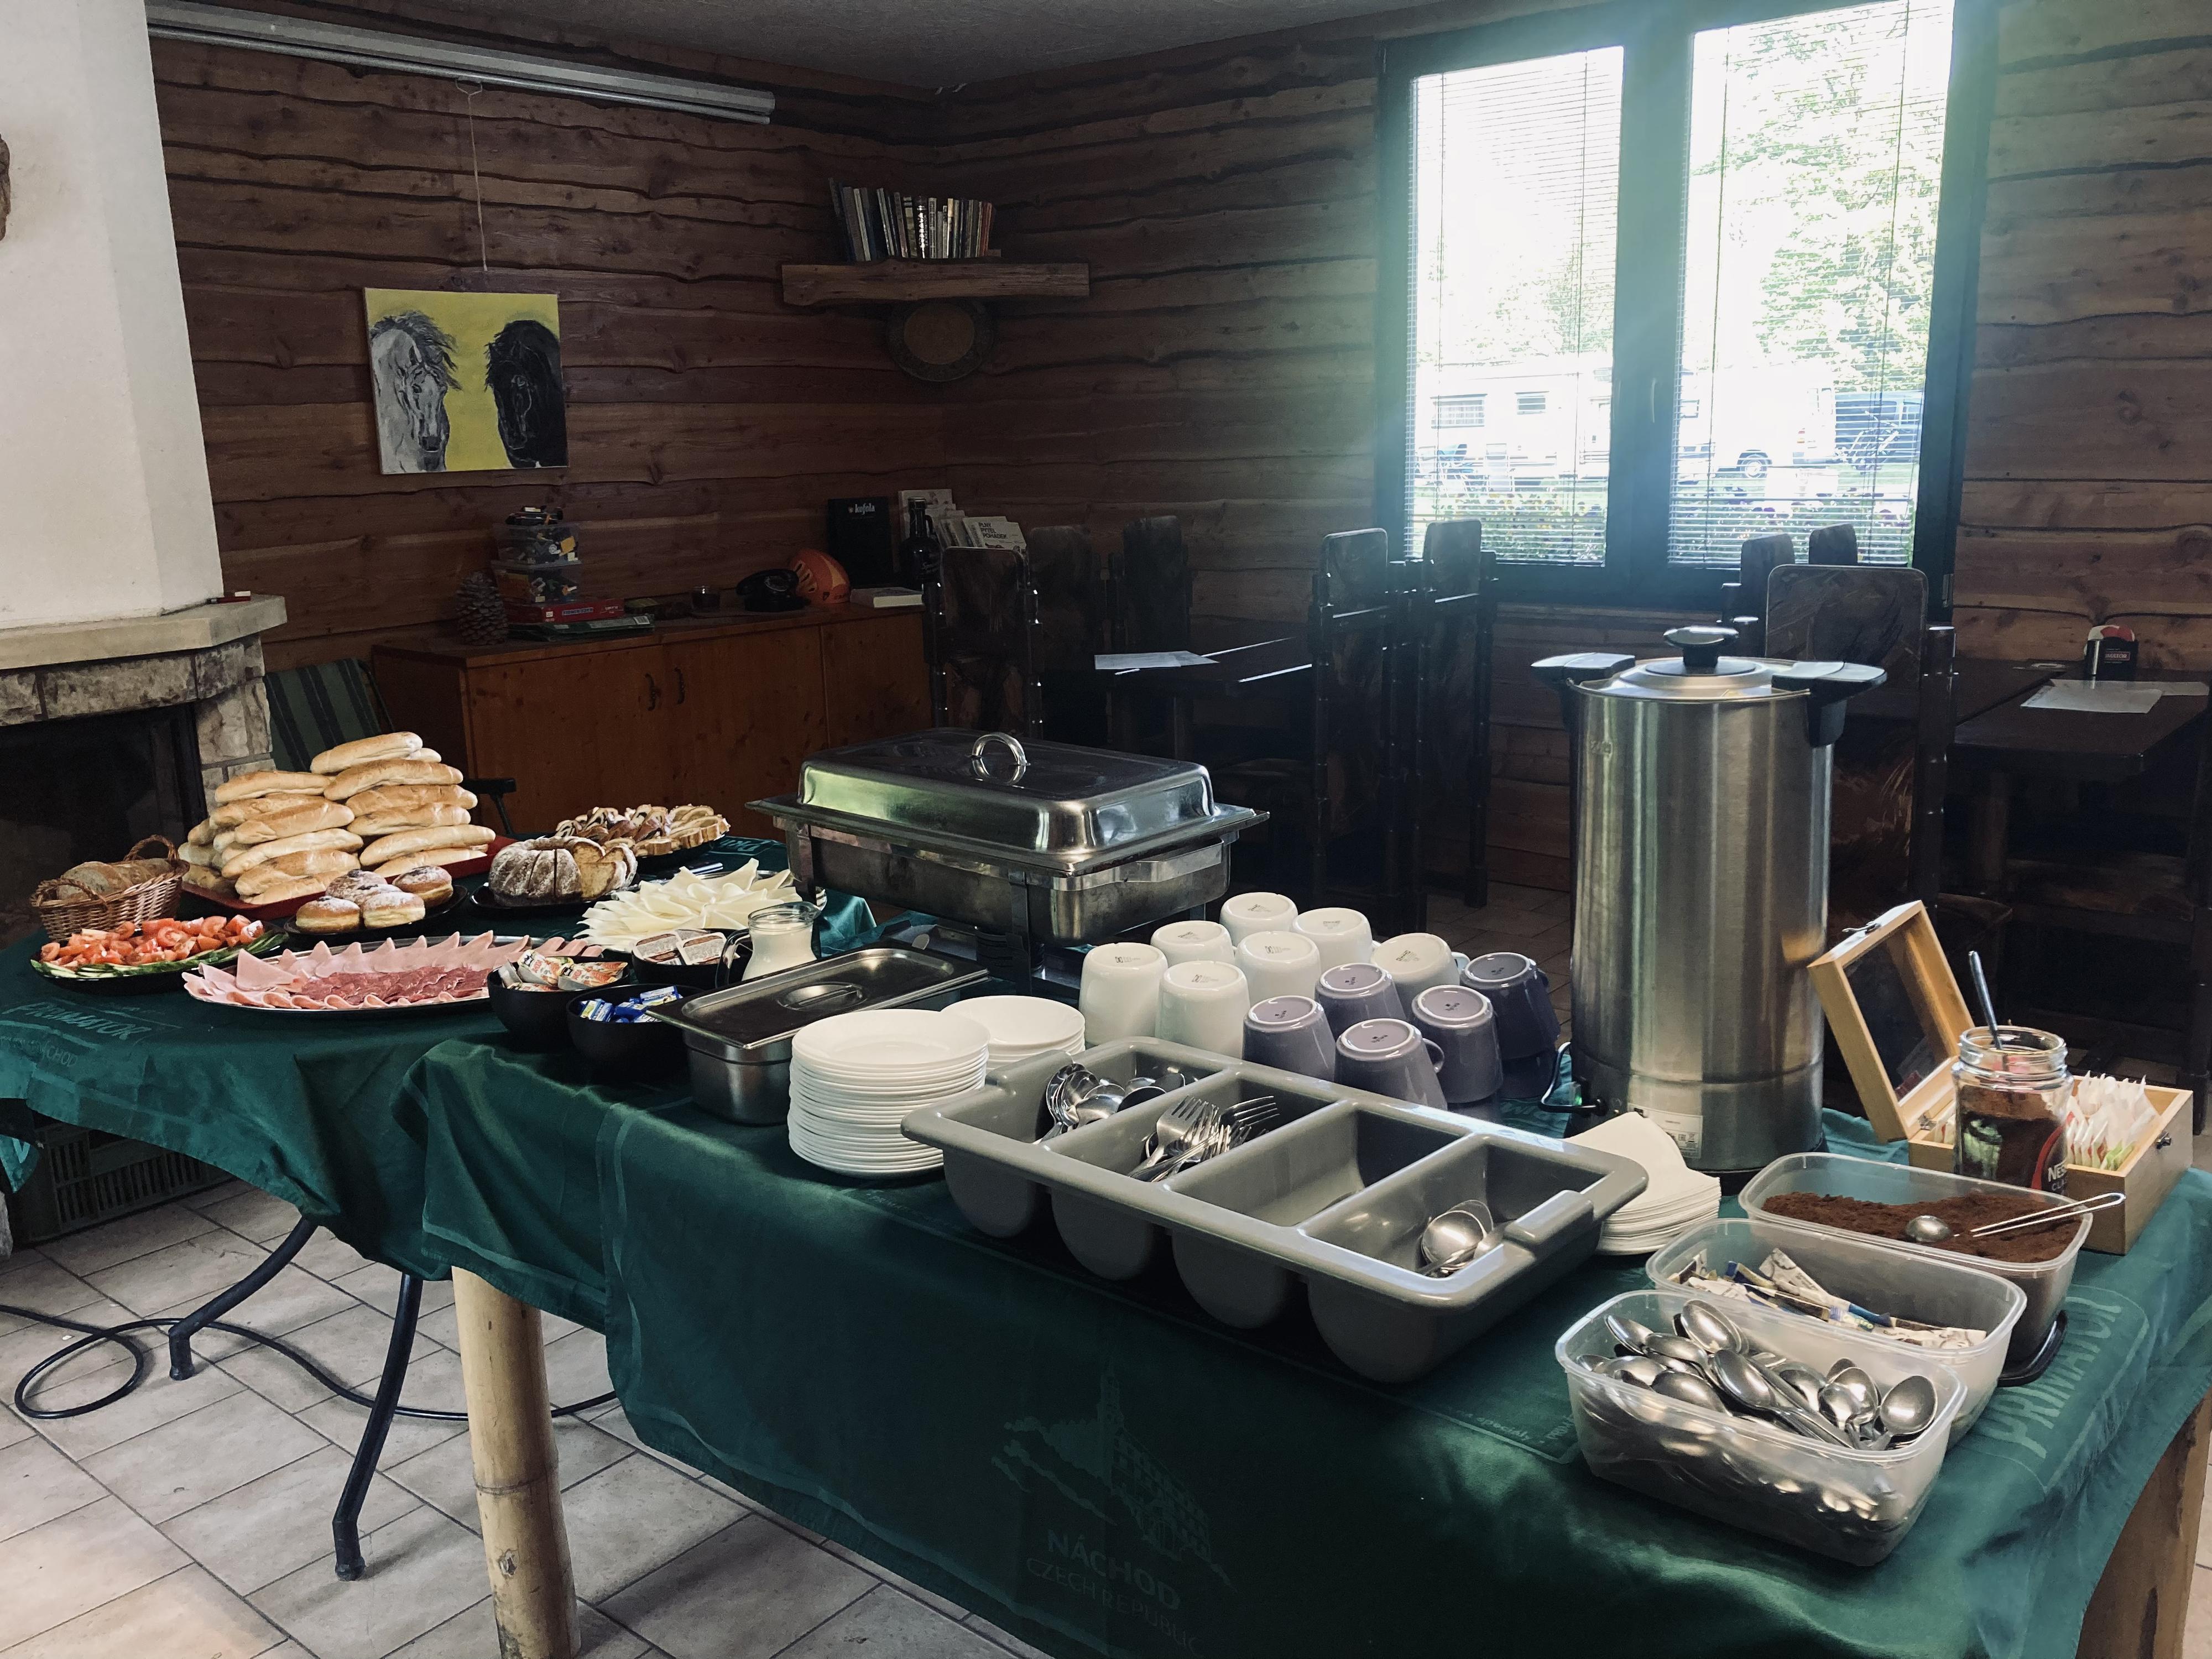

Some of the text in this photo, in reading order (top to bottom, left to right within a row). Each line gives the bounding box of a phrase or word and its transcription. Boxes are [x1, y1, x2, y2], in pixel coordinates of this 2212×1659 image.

[854, 502, 875, 515] kofola
[1026, 1557, 1204, 1658] CZECH REPUBLIC
